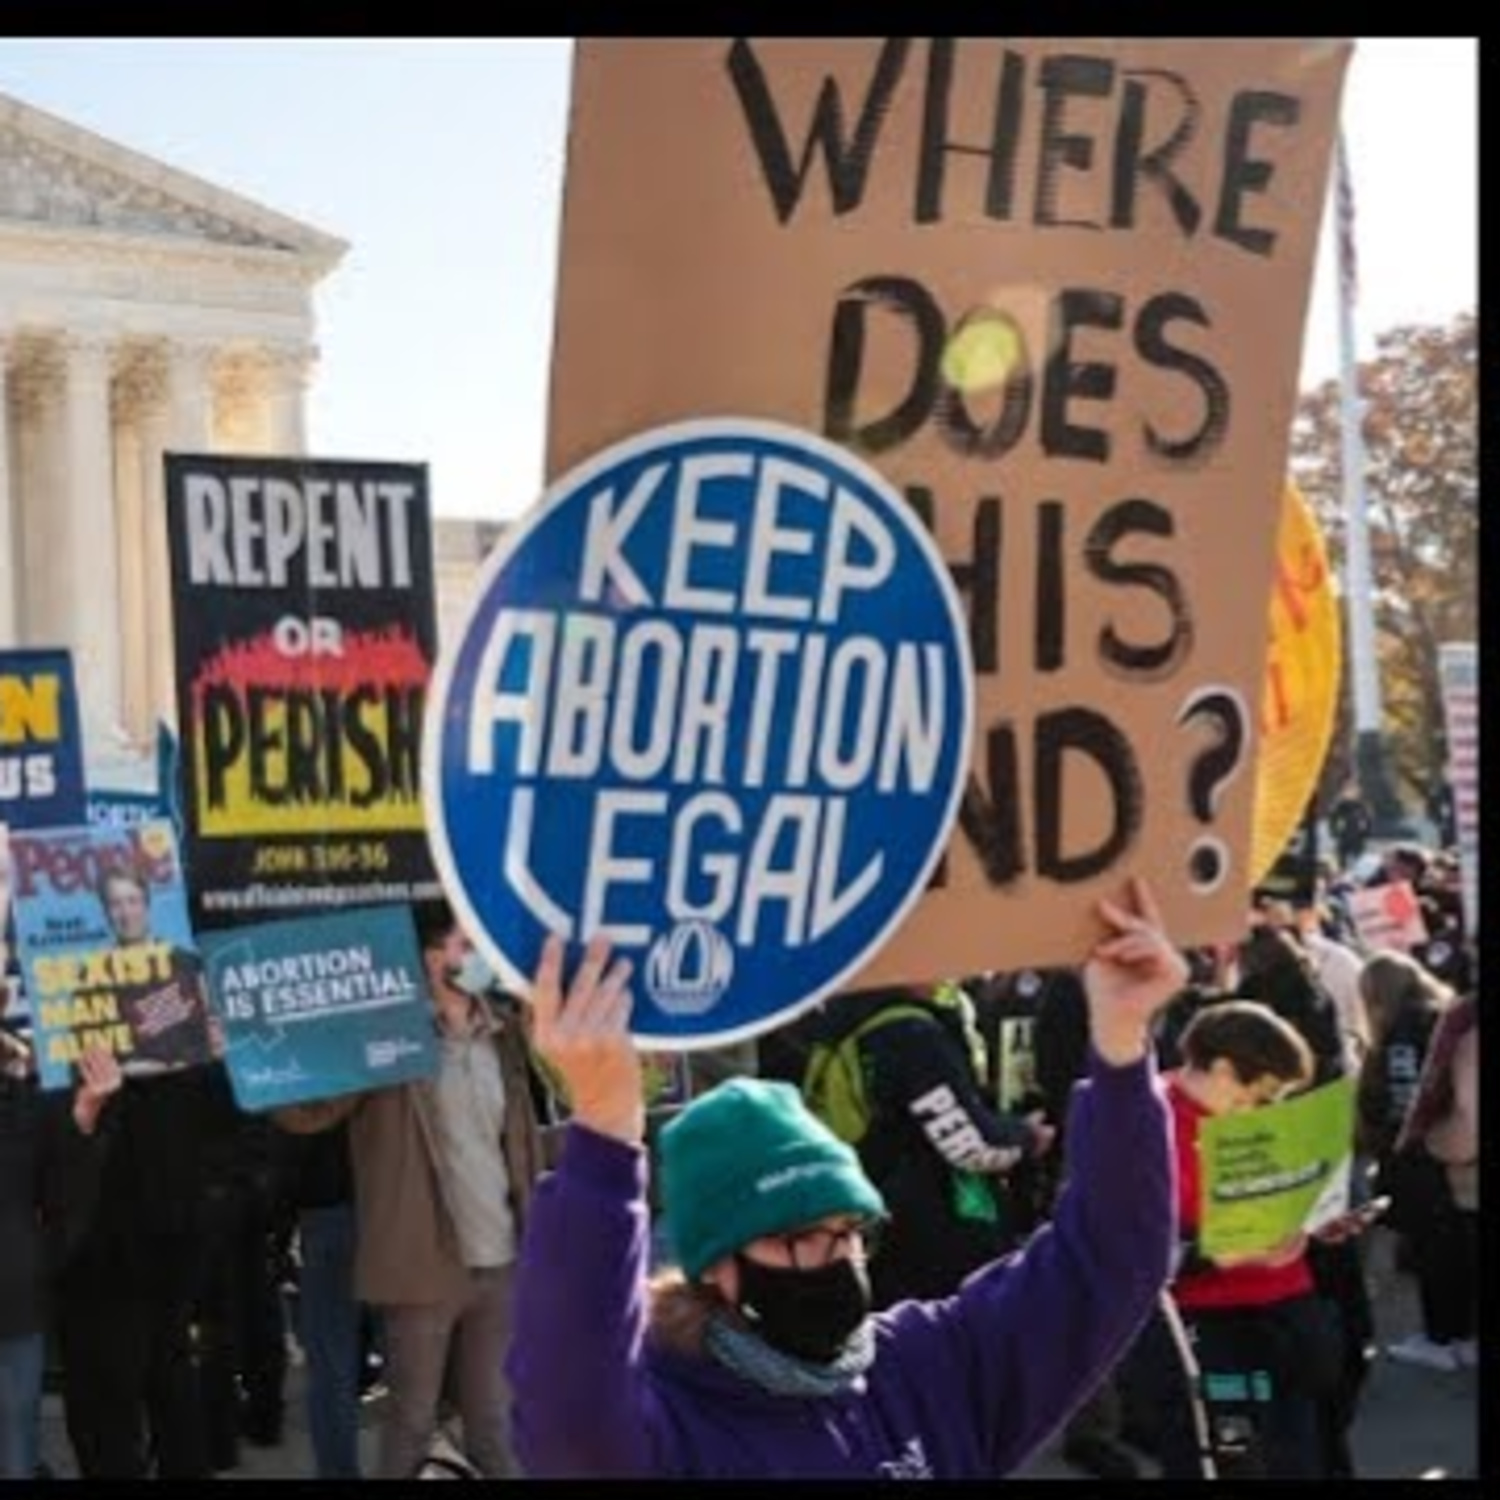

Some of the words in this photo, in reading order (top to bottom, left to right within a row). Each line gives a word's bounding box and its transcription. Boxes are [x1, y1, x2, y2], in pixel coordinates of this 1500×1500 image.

[725, 37, 1300, 256] WHERE
[823, 275, 1231, 465] DOES
[183, 473, 414, 589] REPENT
[578, 452, 898, 624] KEEP
[903, 484, 1193, 682] HIS
[272, 615, 344, 659] OR
[467, 607, 947, 793] ABORTION
[203, 682, 421, 814] PERISH
[503, 786, 885, 947] LEGAL
[33, 945, 173, 995] SEXIST
[40, 992, 120, 1030] MAN
[222, 946, 373, 993] ABORTION
[226, 991, 255, 1019] IS
[260, 967, 417, 1014] ESSENTIAL
